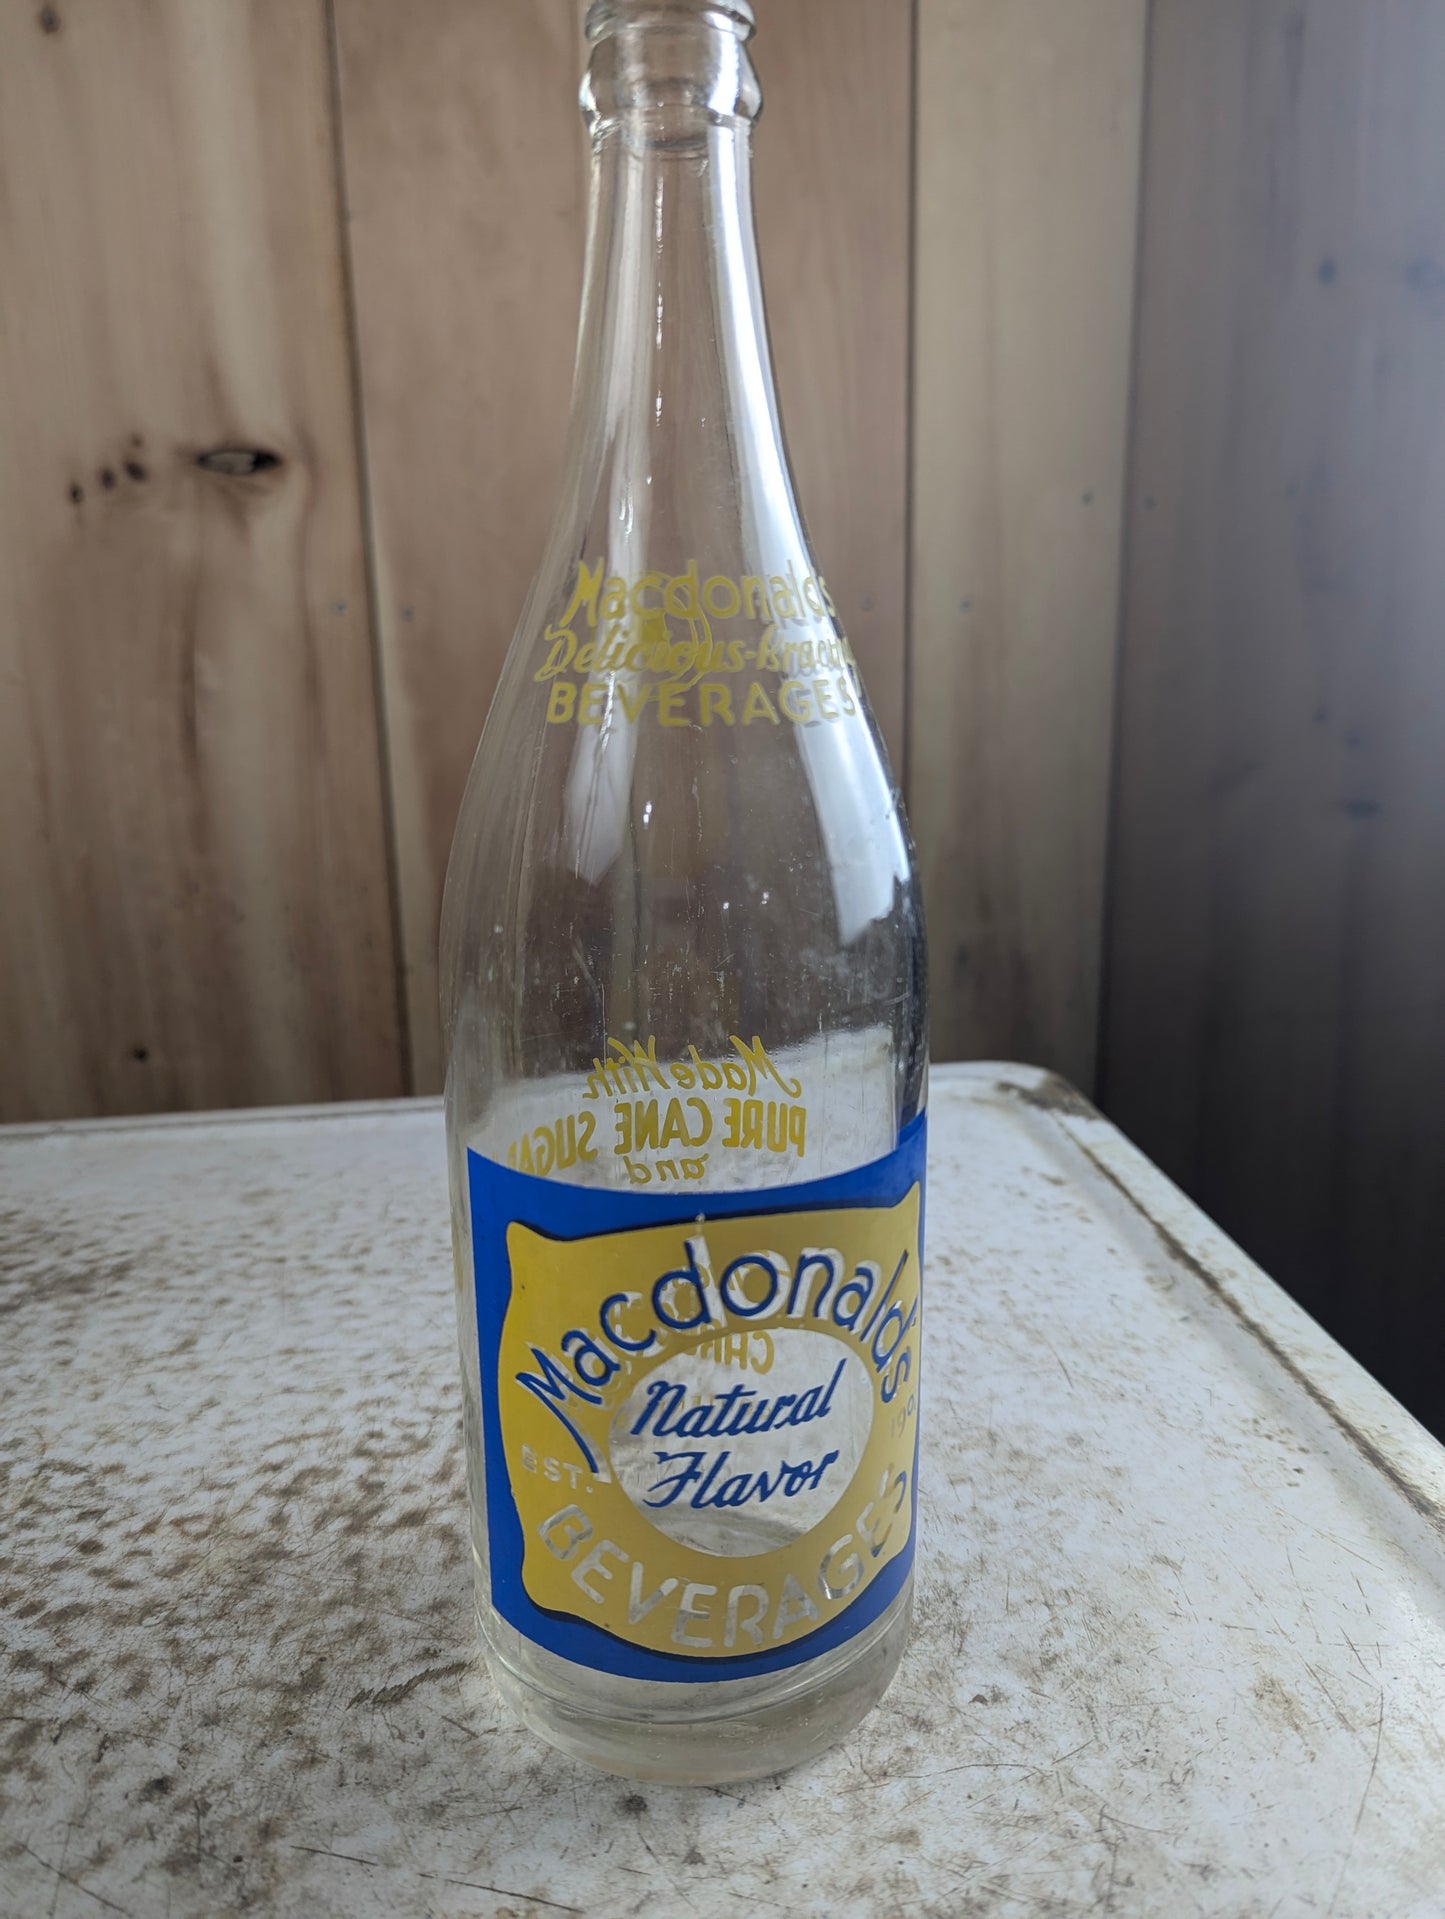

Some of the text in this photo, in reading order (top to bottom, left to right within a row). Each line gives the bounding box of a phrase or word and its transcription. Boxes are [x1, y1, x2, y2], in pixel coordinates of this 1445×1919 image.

[546, 678, 857, 726] BEVERAGES
[629, 1356, 849, 1439] Natural
[521, 1443, 595, 1496] EST.
[641, 1448, 842, 1510] Flavor
[535, 1461, 908, 1650] BEVERAGES
